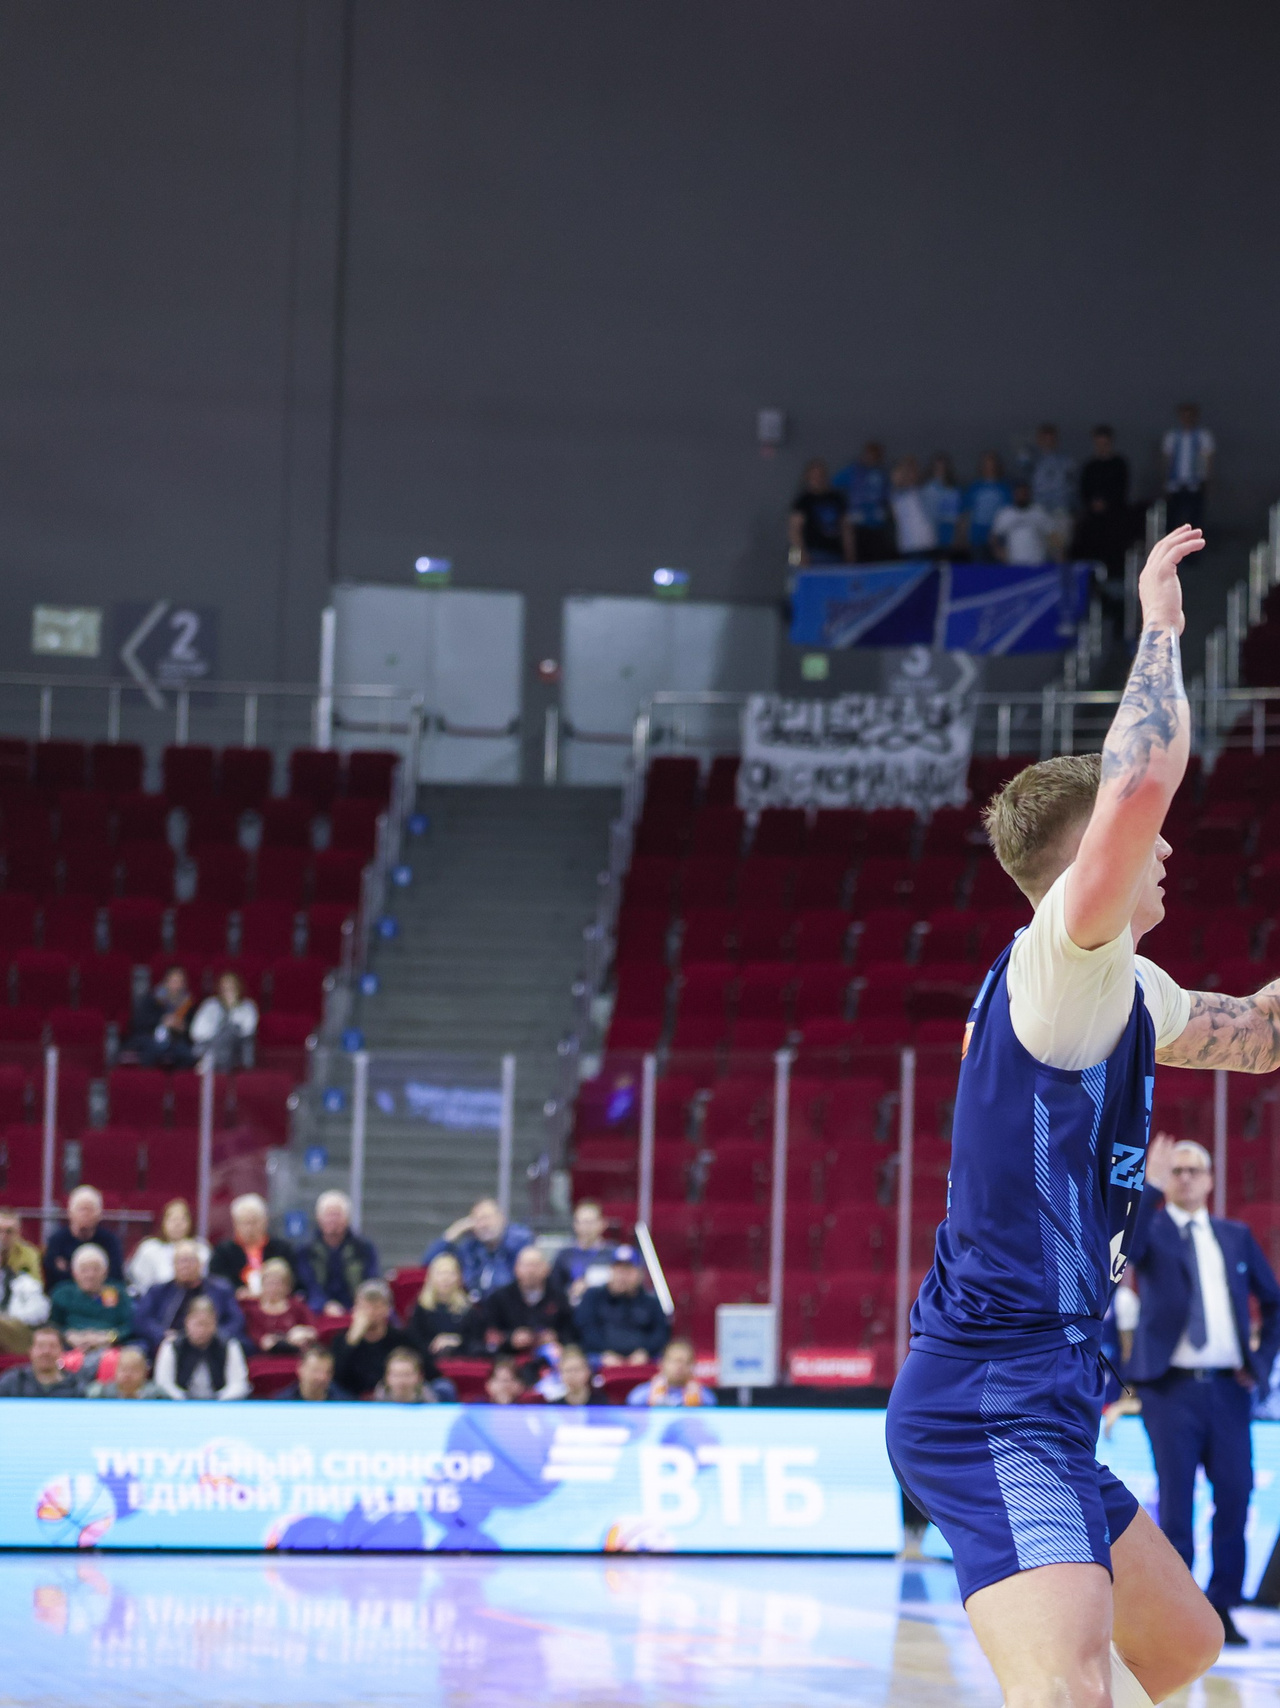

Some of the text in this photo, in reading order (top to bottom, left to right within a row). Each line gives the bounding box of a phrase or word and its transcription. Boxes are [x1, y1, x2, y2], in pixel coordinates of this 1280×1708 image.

[170, 610, 199, 661] 2
[323, 1450, 494, 1481] СПОНСОР
[640, 1445, 824, 1527] ВТБ
